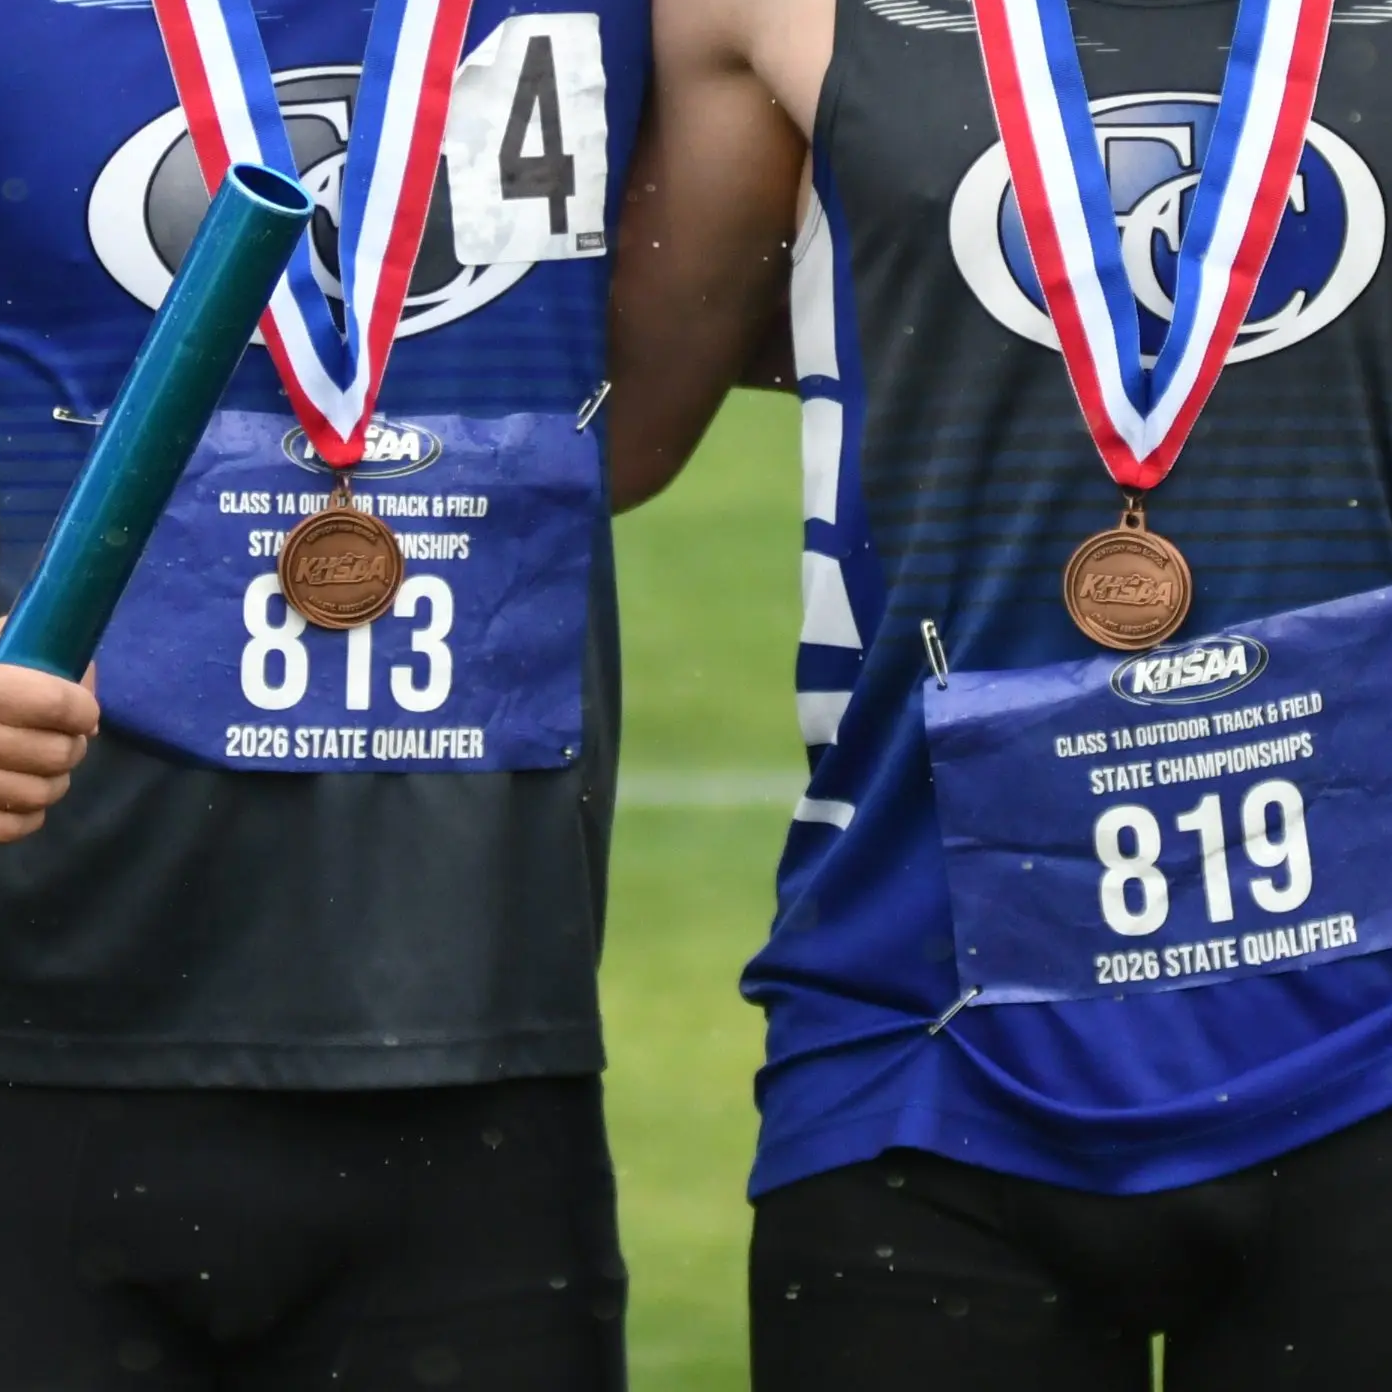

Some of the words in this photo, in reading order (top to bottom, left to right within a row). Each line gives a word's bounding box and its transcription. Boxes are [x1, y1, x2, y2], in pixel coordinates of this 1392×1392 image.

[498, 35, 576, 235] 4
[219, 493, 270, 514] CLASS
[275, 494, 295, 515] 1A
[299, 494, 373, 516] OUTOR
[378, 495, 428, 518] TRACK
[432, 496, 444, 517] &
[446, 496, 488, 519] FIELD
[248, 531, 286, 557] STA
[240, 574, 454, 713] 813
[1132, 645, 1248, 693] KHSAA
[225, 727, 288, 758] 2026
[293, 728, 367, 760] STATE
[371, 728, 484, 760] QUALIFIER
[1055, 733, 1107, 759] CLASS
[1111, 728, 1133, 751] 1A
[1136, 718, 1210, 747] OUTDOOR
[1212, 709, 1264, 735] TRACK
[1267, 704, 1279, 726] &
[1281, 693, 1322, 722] FIELD
[1090, 762, 1154, 795] STATE
[1157, 732, 1314, 785] CHAMPIONSHIPS
[1093, 778, 1313, 937] 819
[1095, 950, 1160, 985] 2026
[1163, 938, 1239, 978] STATE
[1243, 914, 1357, 967] QUALIFIER
